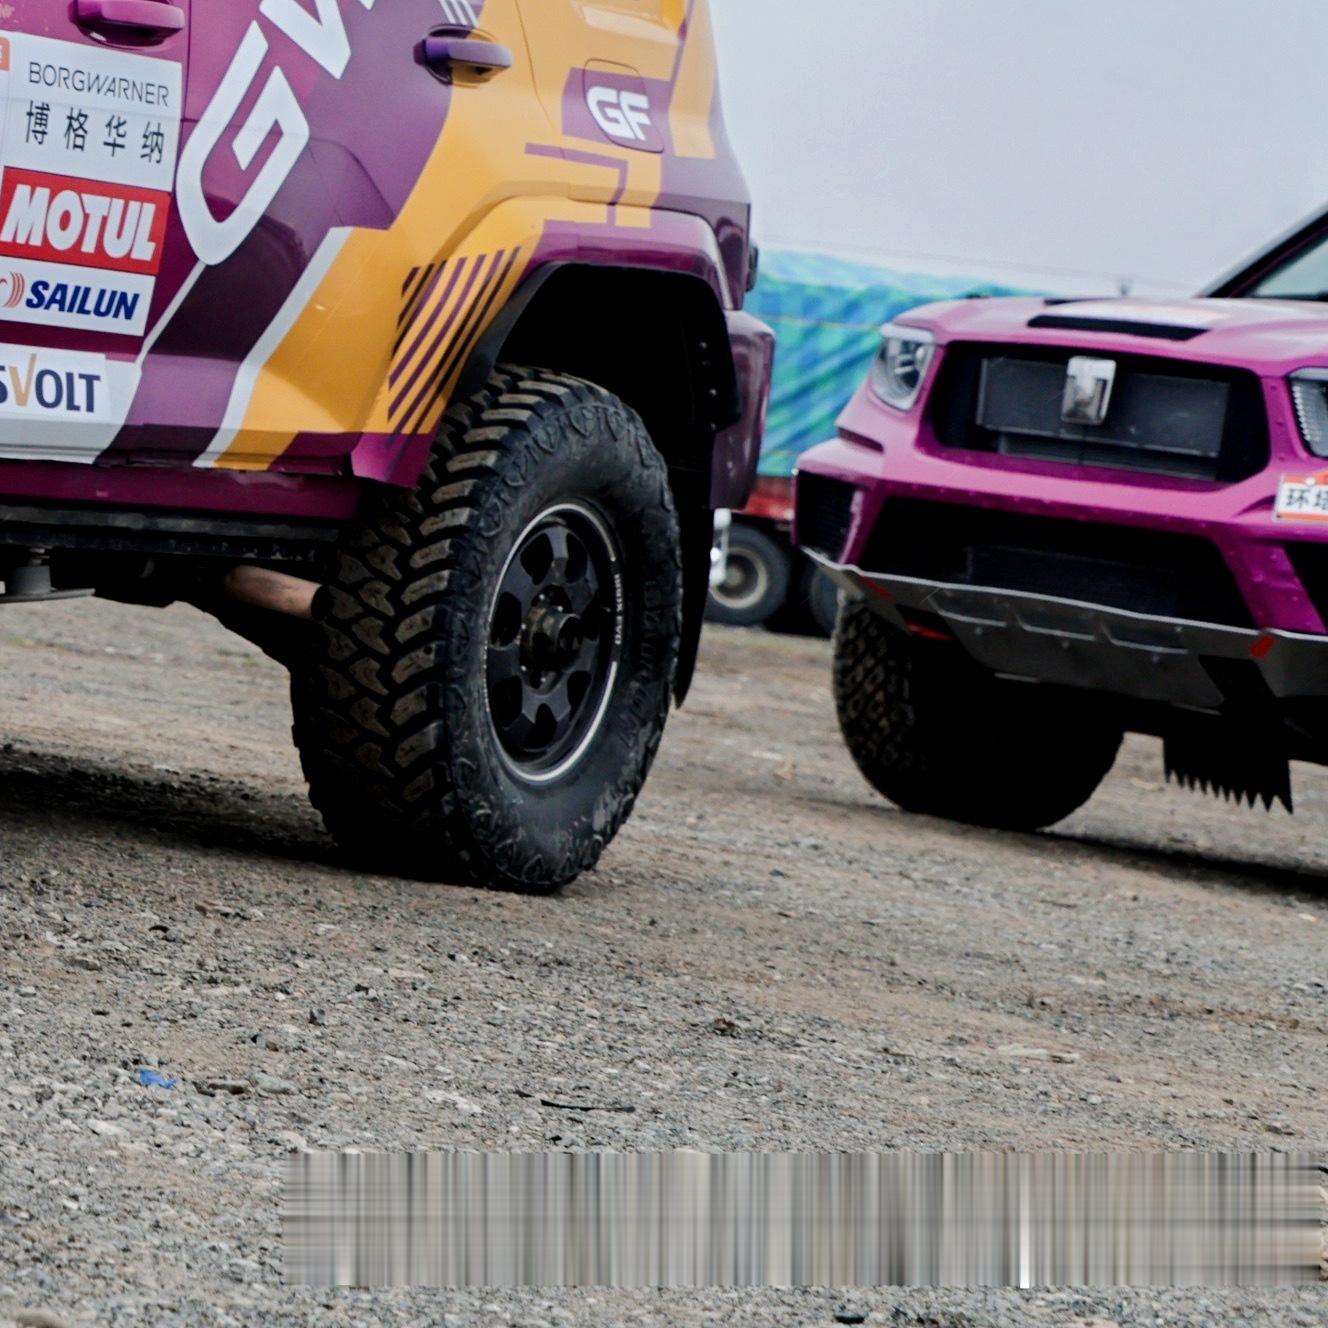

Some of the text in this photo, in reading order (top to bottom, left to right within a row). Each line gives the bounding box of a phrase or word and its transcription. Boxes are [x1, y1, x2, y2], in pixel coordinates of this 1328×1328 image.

[28, 61, 170, 108] BORGWARNER
[24, 99, 165, 165] 博格华纳
[586, 85, 653, 142] GF
[0, 183, 158, 263] MOTUL
[25, 279, 140, 322] SAILUN
